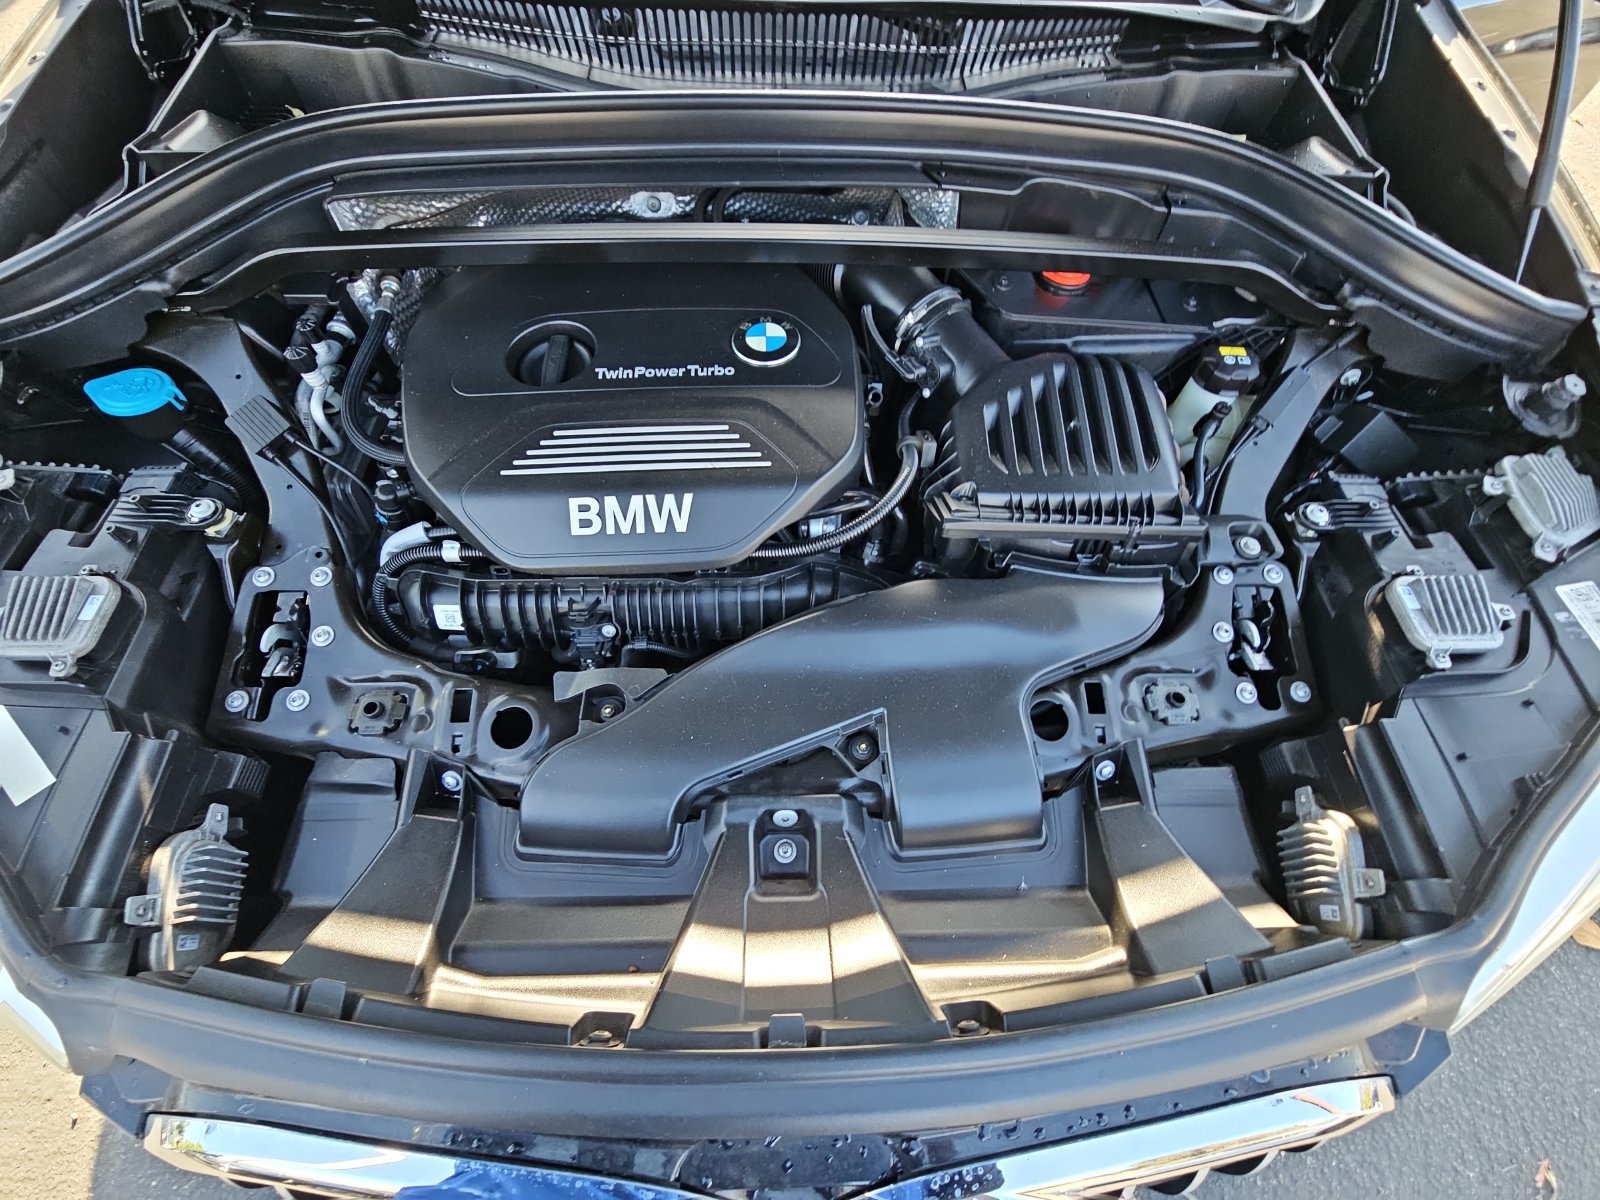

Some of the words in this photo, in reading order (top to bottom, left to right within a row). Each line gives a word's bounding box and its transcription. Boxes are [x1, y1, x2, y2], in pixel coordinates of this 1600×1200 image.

[739, 316, 793, 330] BMW
[686, 364, 736, 377] Turbo
[568, 492, 694, 536] BMW
